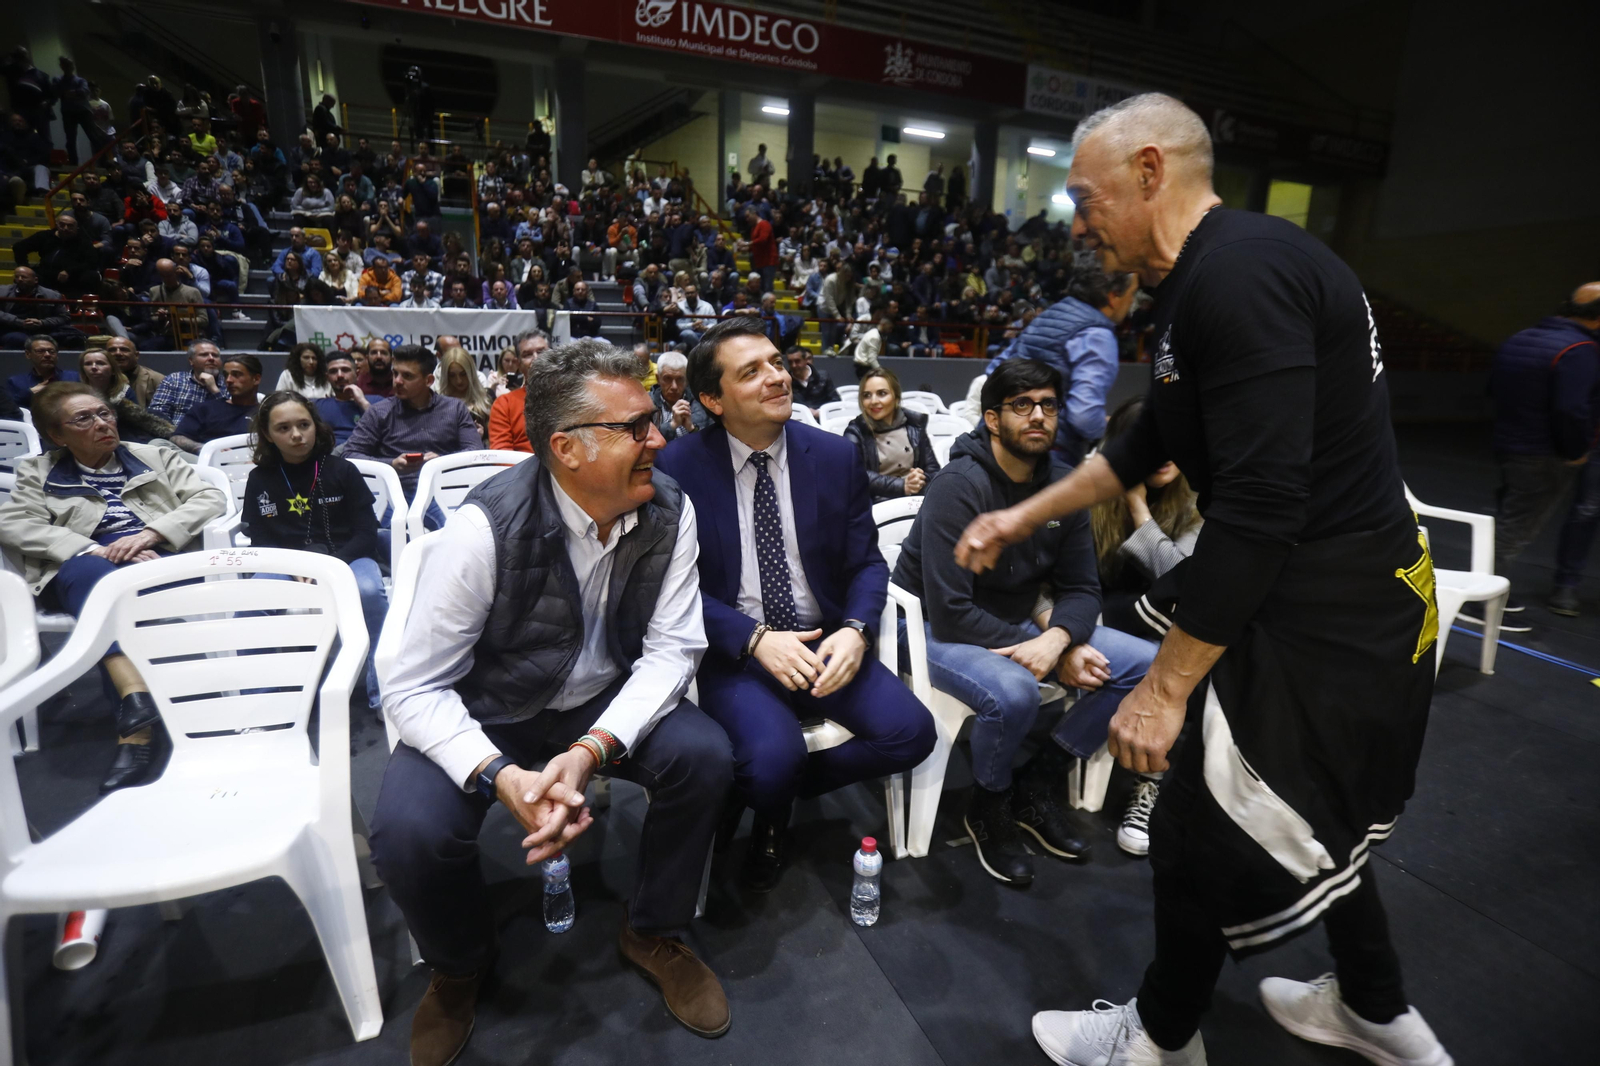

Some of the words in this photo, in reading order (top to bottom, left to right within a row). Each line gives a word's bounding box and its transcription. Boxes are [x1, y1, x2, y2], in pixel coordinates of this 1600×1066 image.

[401, 0, 553, 26] GRE
[681, 1, 819, 54] IMDECO
[636, 31, 677, 48] Instituto
[678, 37, 725, 55] Municipal
[726, 46, 738, 56] de
[739, 48, 780, 64] Deportes
[782, 54, 818, 70] Córdoba
[420, 334, 517, 351] PRIMO
[226, 556, 243, 566] 55
